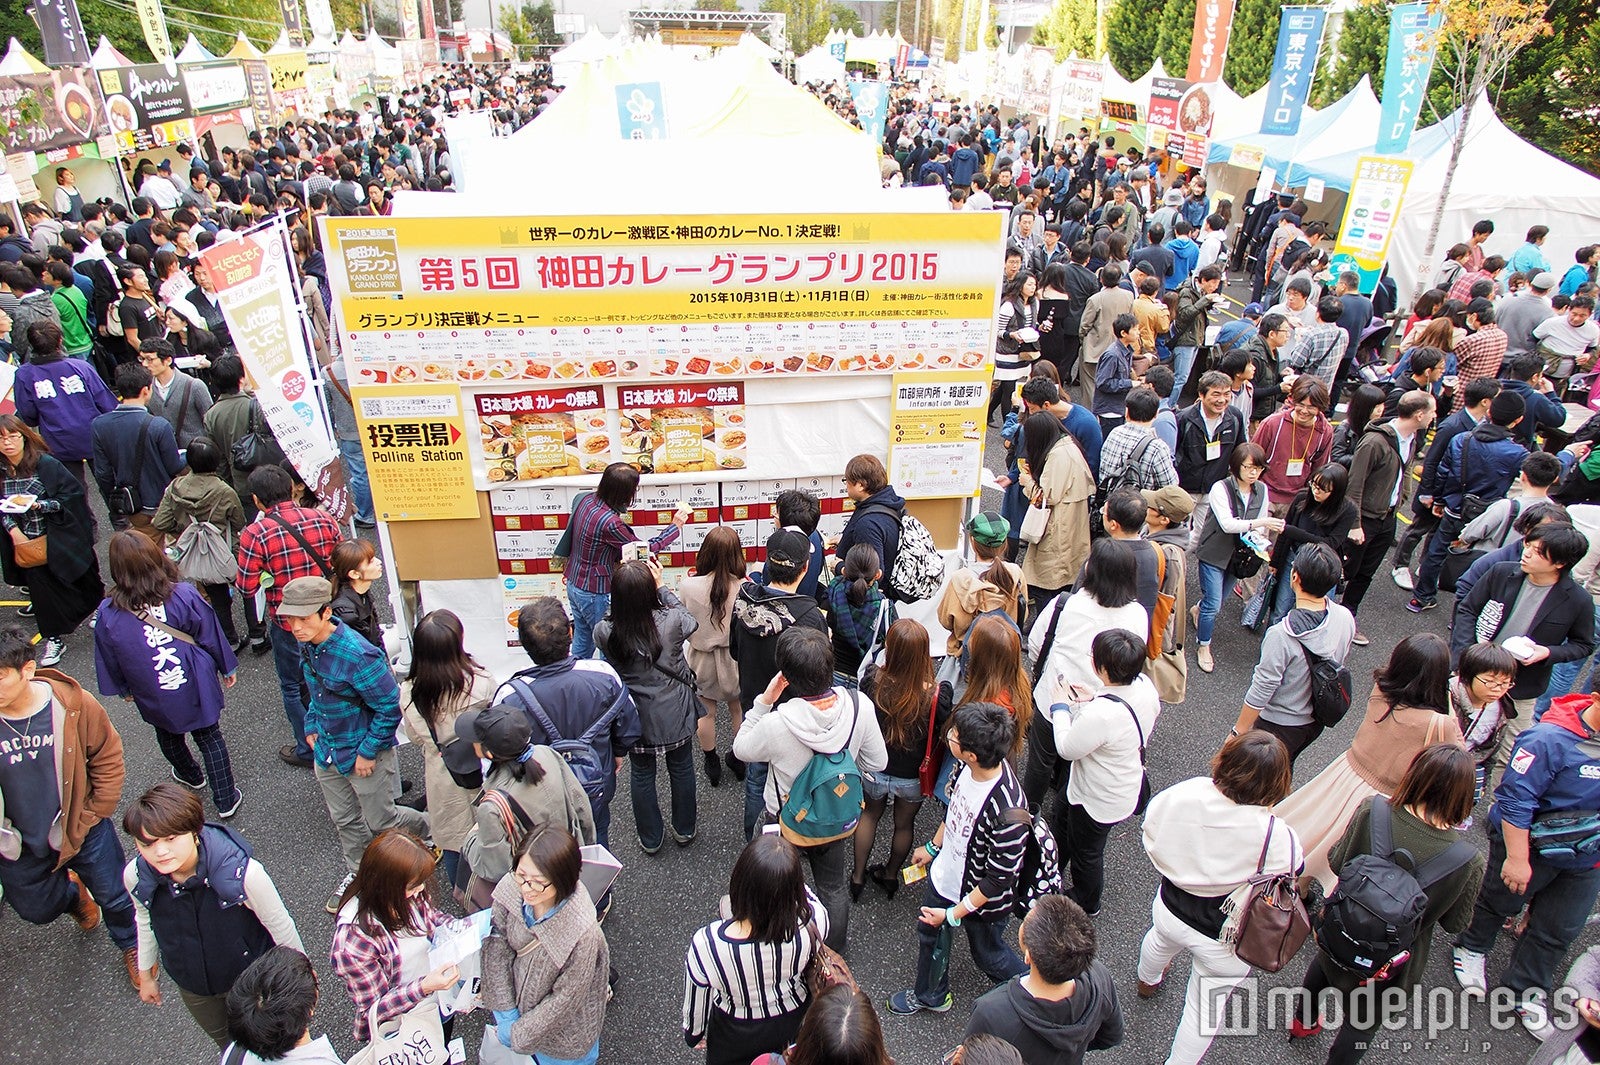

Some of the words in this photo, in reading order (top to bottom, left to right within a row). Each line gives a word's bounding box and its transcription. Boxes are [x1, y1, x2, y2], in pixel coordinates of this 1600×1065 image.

[1274, 33, 1306, 124] 東京メトロ
[1391, 33, 1421, 140] 東京メトロ
[345, 245, 395, 260] 神田カレー
[348, 258, 397, 273] グランプリ
[418, 256, 521, 292] 第5回
[350, 274, 375, 282] KANDA
[375, 273, 398, 281] CURRY
[358, 311, 540, 328] グランプリ決定戦メニュー
[33, 374, 86, 399] 明治
[898, 385, 983, 399] 本部案内所・報道受付
[480, 395, 534, 414] 日本最大級
[536, 391, 599, 409] カレーの祭典
[623, 389, 675, 406] 日本最大級
[678, 386, 739, 403] カレーの祭典
[909, 400, 952, 408] Information
[366, 422, 450, 448] 投票場
[372, 451, 415, 463] Polling
[421, 450, 464, 462] Station
